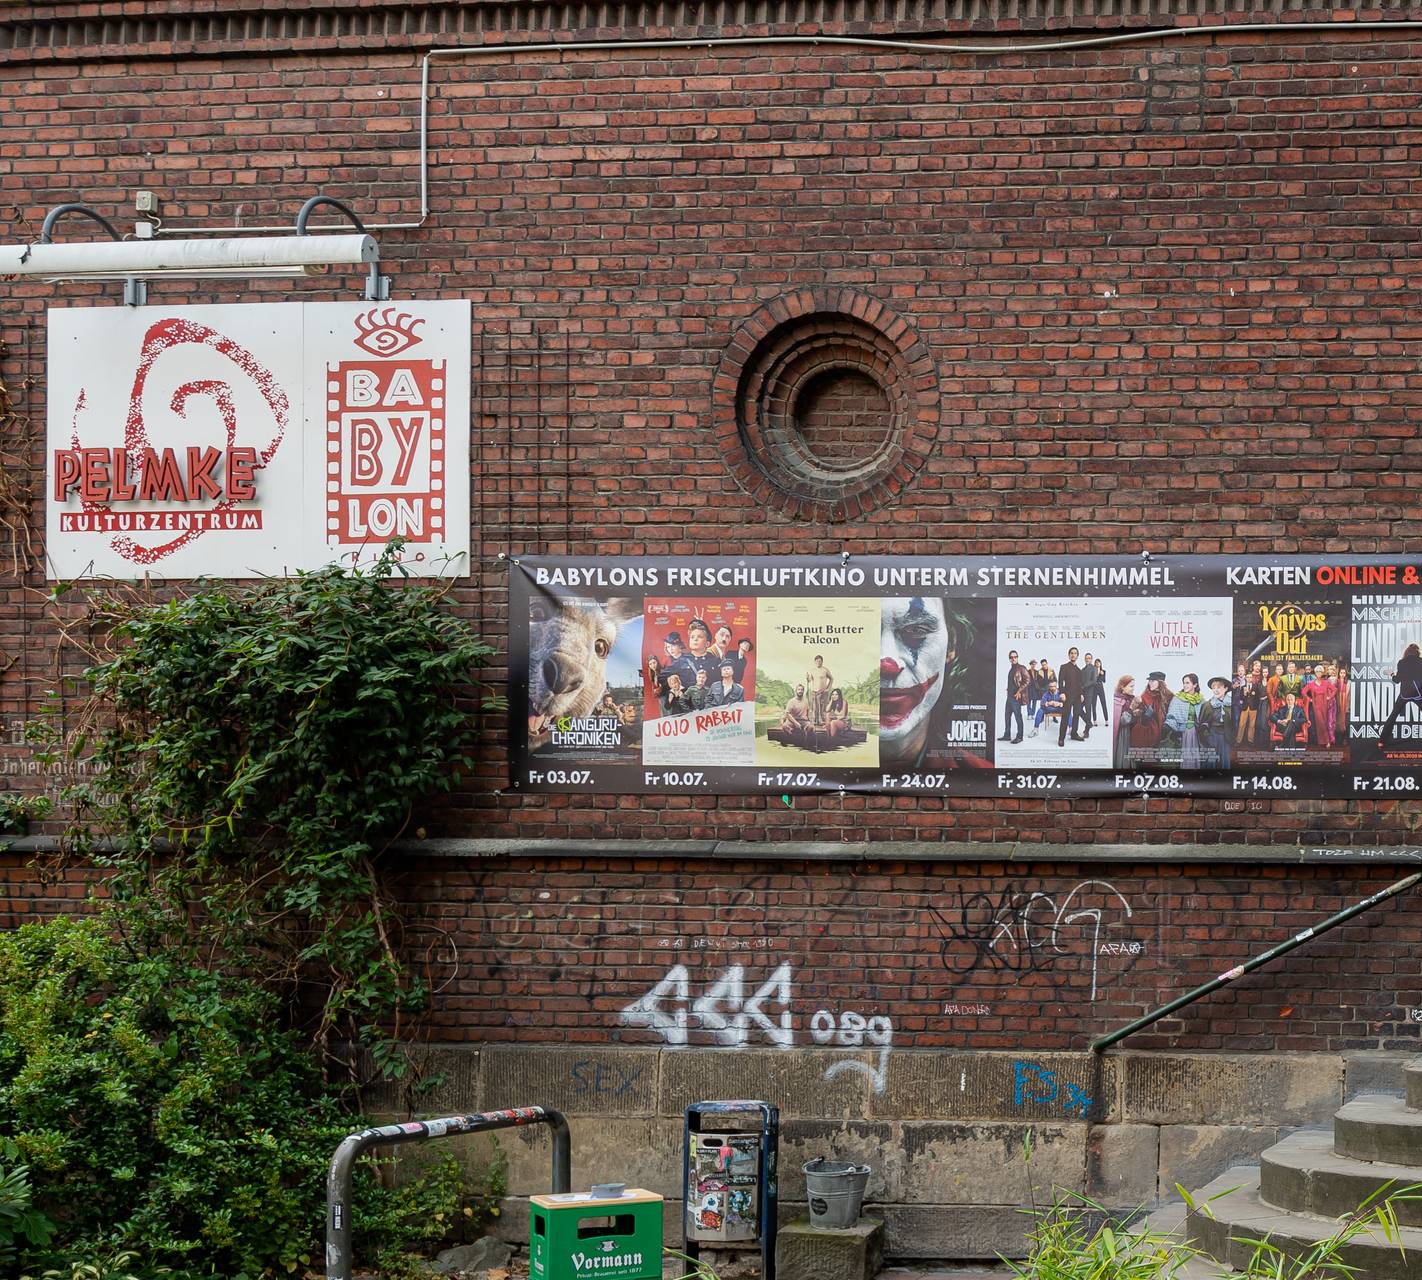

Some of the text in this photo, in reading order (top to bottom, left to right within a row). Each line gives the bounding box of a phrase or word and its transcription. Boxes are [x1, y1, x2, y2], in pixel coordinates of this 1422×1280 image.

[346, 368, 424, 407] BA
[351, 417, 424, 486] BY
[54, 446, 258, 502] PELMKE
[62, 513, 260, 531] KULTURZENTRUM
[348, 498, 424, 537] LON
[536, 567, 659, 587] BABYLONS
[667, 567, 866, 587] FRISCHLUFTKINO
[874, 567, 969, 586] UNTERM
[977, 567, 1175, 586] STERNENHIMMEL
[1226, 567, 1311, 586] KARTEN
[1316, 566, 1397, 586] ONLINE
[1402, 566, 1419, 585] &
[1259, 605, 1327, 631] Knives
[782, 625, 822, 635] Peanut
[826, 625, 864, 635] Butter
[1153, 620, 1195, 635] LITTLE
[803, 635, 840, 645] Falcon
[1006, 631, 1107, 640] THE GENTLEMEN
[1150, 636, 1199, 649] WOMEN
[1276, 630, 1308, 655] Out
[655, 719, 690, 738] JOJO
[695, 709, 743, 734] RABBIT
[946, 720, 987, 742] JOKER
[552, 732, 622, 746] CHRONIKEN
[530, 771, 595, 785] Fr 03.07.
[645, 773, 707, 786] Fr 10.07.
[758, 773, 821, 787] Fr 17.07.
[883, 775, 950, 789] Fr 24.07.
[998, 775, 1061, 789] Fr 31.07.
[1115, 775, 1184, 789] Fr 07.08.
[1233, 776, 1297, 790] Fr 14.08.
[1353, 776, 1420, 791] Fr 21.08.
[571, 1252, 642, 1271] Vormann
